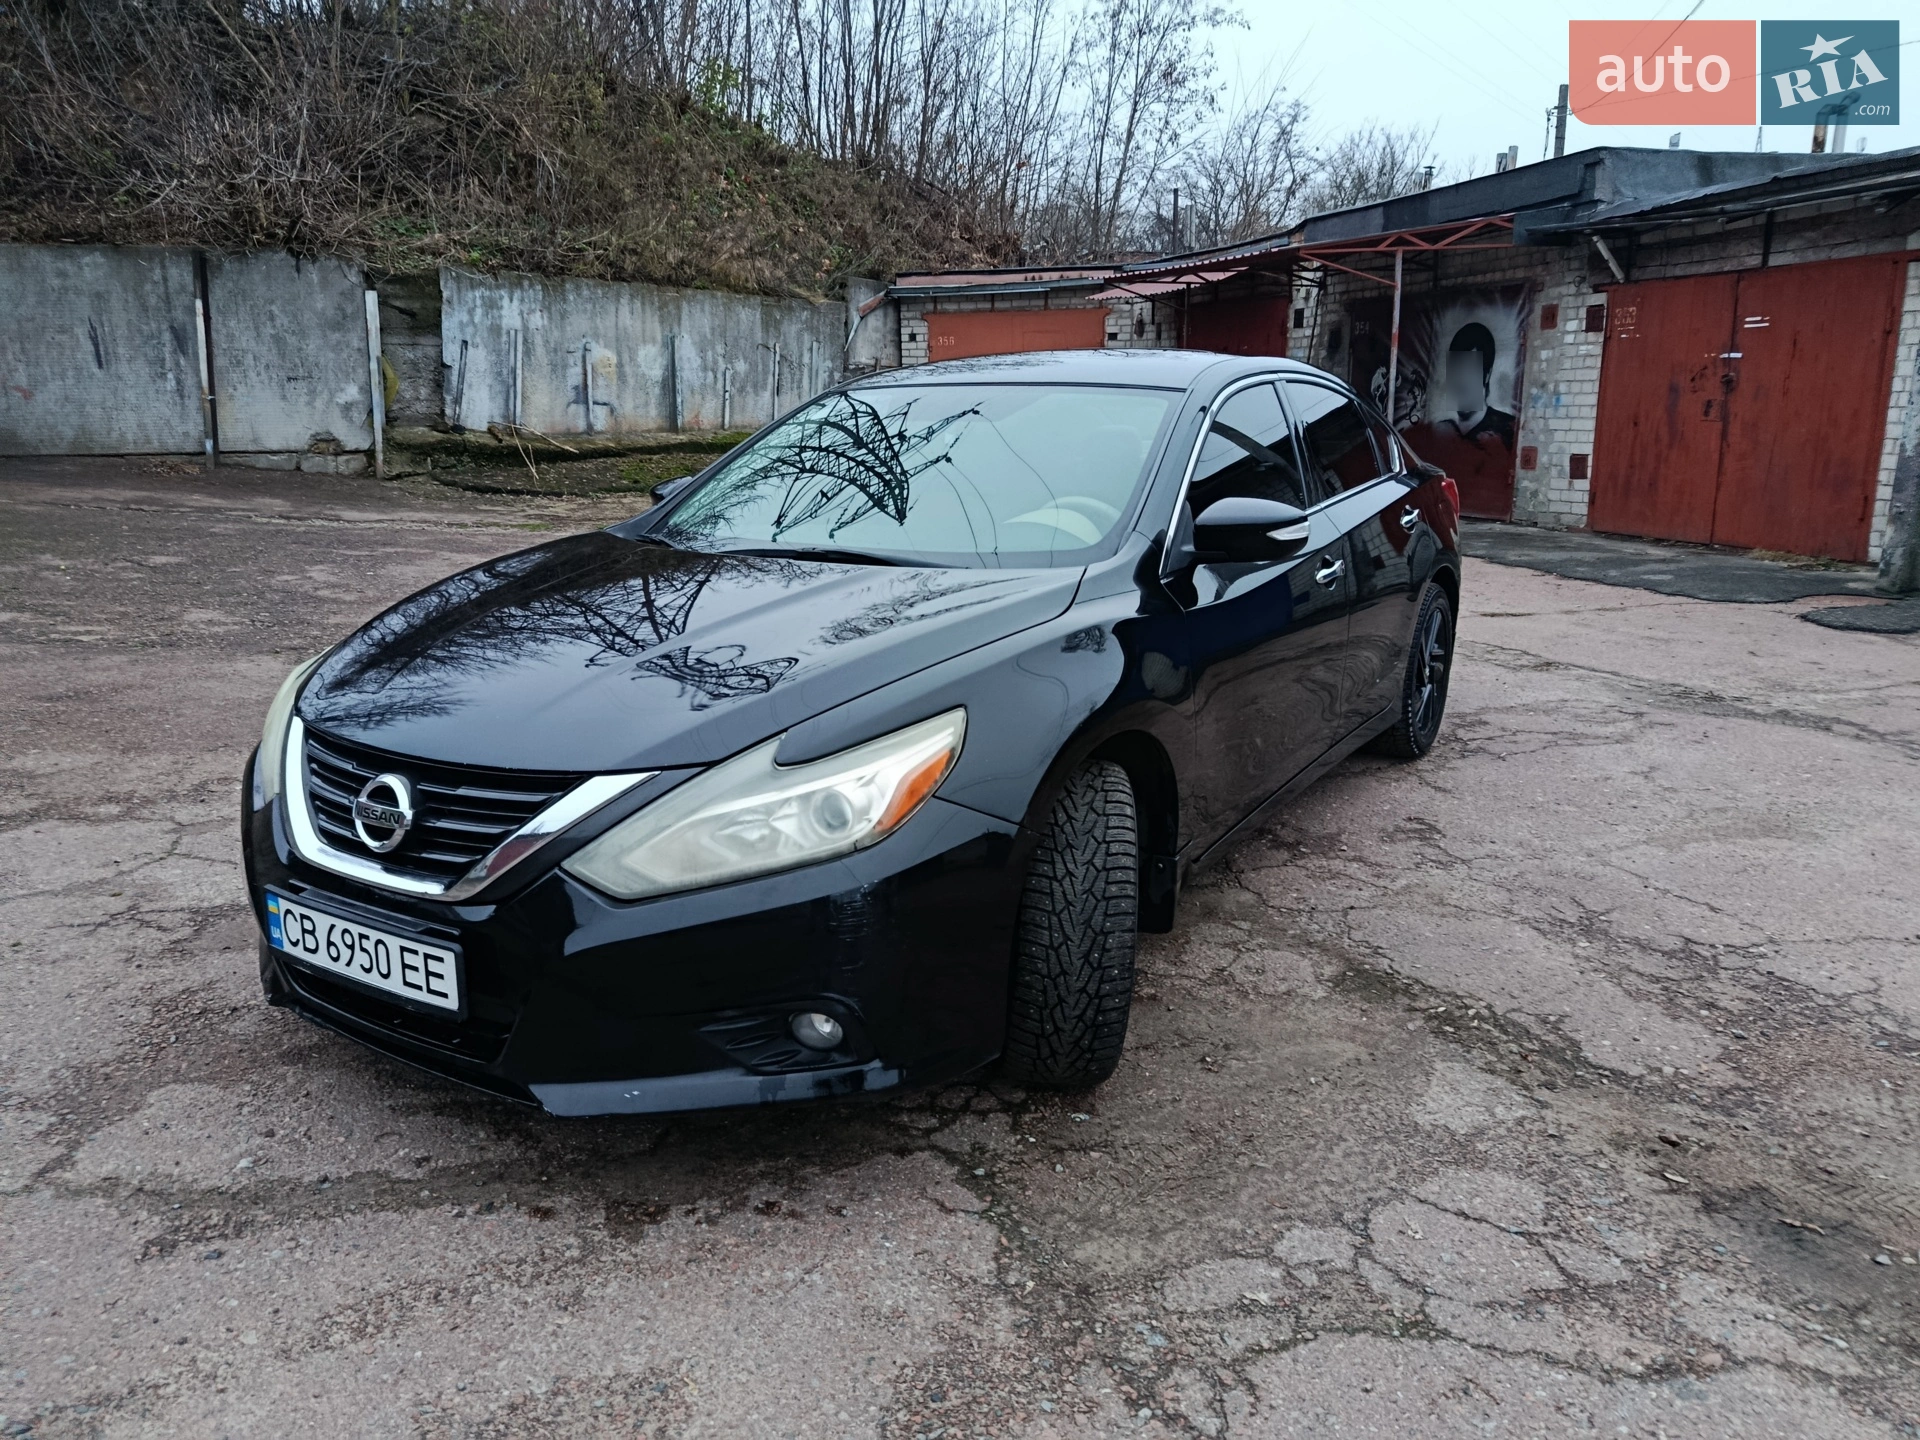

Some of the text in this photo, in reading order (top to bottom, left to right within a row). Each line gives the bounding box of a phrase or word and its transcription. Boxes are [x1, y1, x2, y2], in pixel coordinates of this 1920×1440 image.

[356, 806, 400, 825] NISSAN
[271, 926, 283, 940] UA
[283, 908, 449, 999] CB 6950 EE
